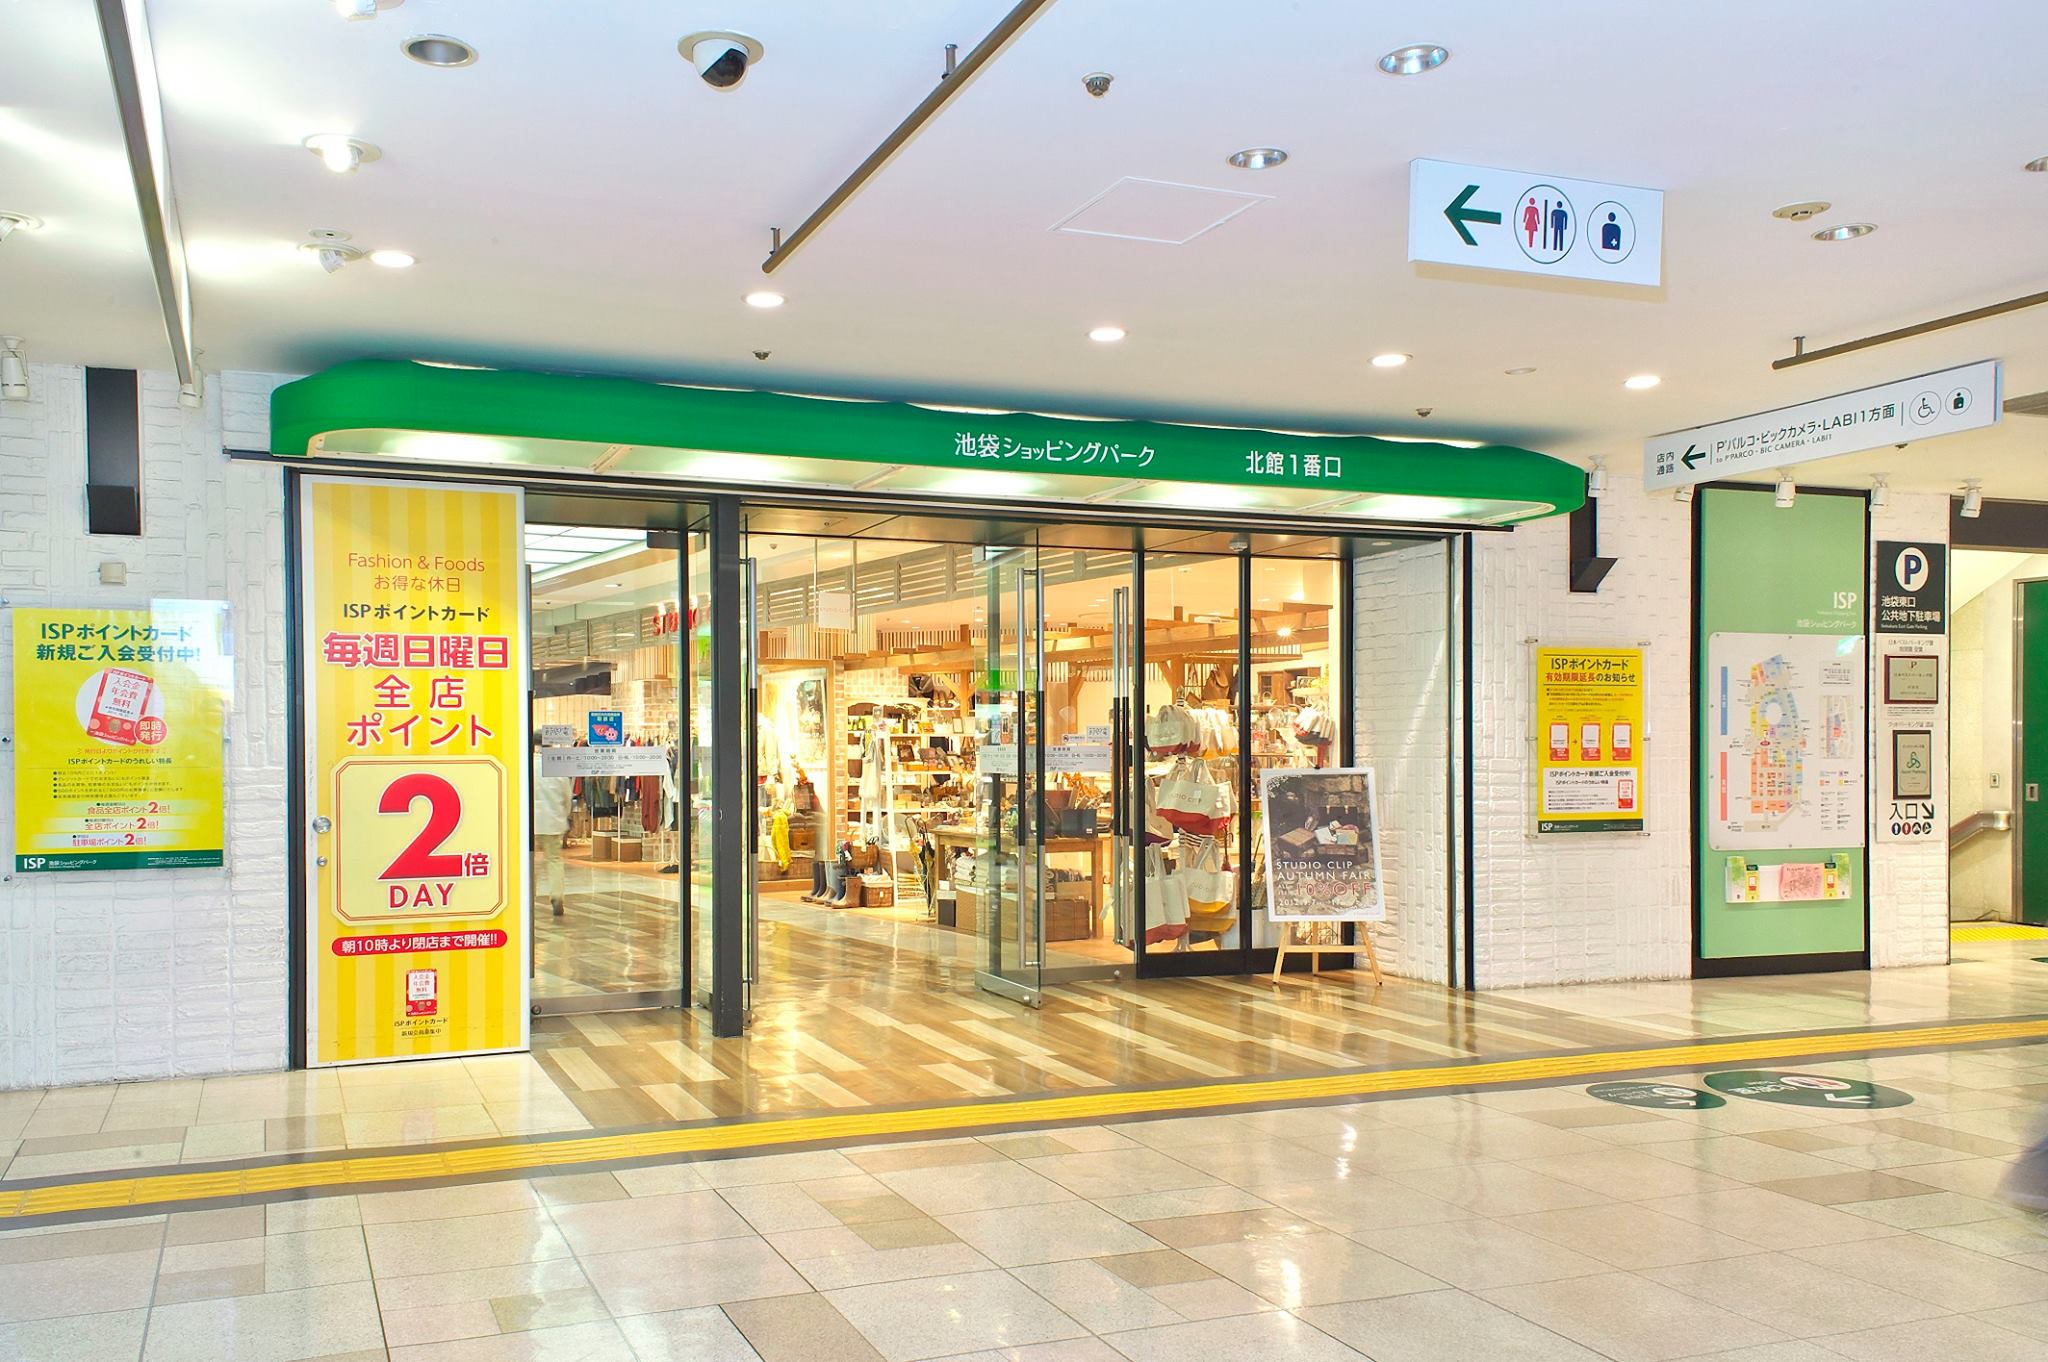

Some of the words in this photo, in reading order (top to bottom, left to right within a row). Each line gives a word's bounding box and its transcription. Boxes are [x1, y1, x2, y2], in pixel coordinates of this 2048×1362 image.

[954, 432, 1156, 468] 池袋ショッピングパーク
[1245, 449, 1342, 478] 北館1番口
[1760, 446, 1772, 454] BIC
[1775, 440, 1805, 451] CAMERA
[1656, 451, 1675, 463] 店内
[1656, 463, 1675, 476] 通路
[348, 552, 412, 570] Fashion
[417, 556, 430, 571] &
[434, 556, 486, 572] Foods
[1904, 554, 1922, 585] P
[374, 576, 461, 593] お得な休日
[1833, 591, 1857, 609] ISP
[1881, 596, 1916, 608] 池袋東口
[343, 603, 490, 623] ISPポイントカード
[1881, 610, 1941, 623] 公共地下駐車場
[41, 623, 194, 643] ISPポイントカード
[36, 644, 200, 663] 新規ご入会受付中!
[322, 632, 509, 670] 毎週日曜日
[1551, 658, 1629, 671] ISPポイントカード
[1545, 672, 1636, 684] 有効期限延長のお知らせ
[374, 674, 465, 709] 全店
[140, 720, 161, 731] 即時
[346, 711, 492, 747] ポイント
[140, 730, 163, 741] 発行
[1888, 802, 1918, 820] 入口
[1541, 822, 1553, 831] ISP
[23, 857, 46, 869] ISP
[1276, 861, 1321, 870] STUDIO
[1327, 861, 1353, 869] CLIP
[1277, 871, 1335, 881] AUTUMN
[1342, 871, 1372, 880] FAIR
[388, 882, 455, 909] DAY
[341, 932, 498, 954] 朝10時より閉店まで開催!!
